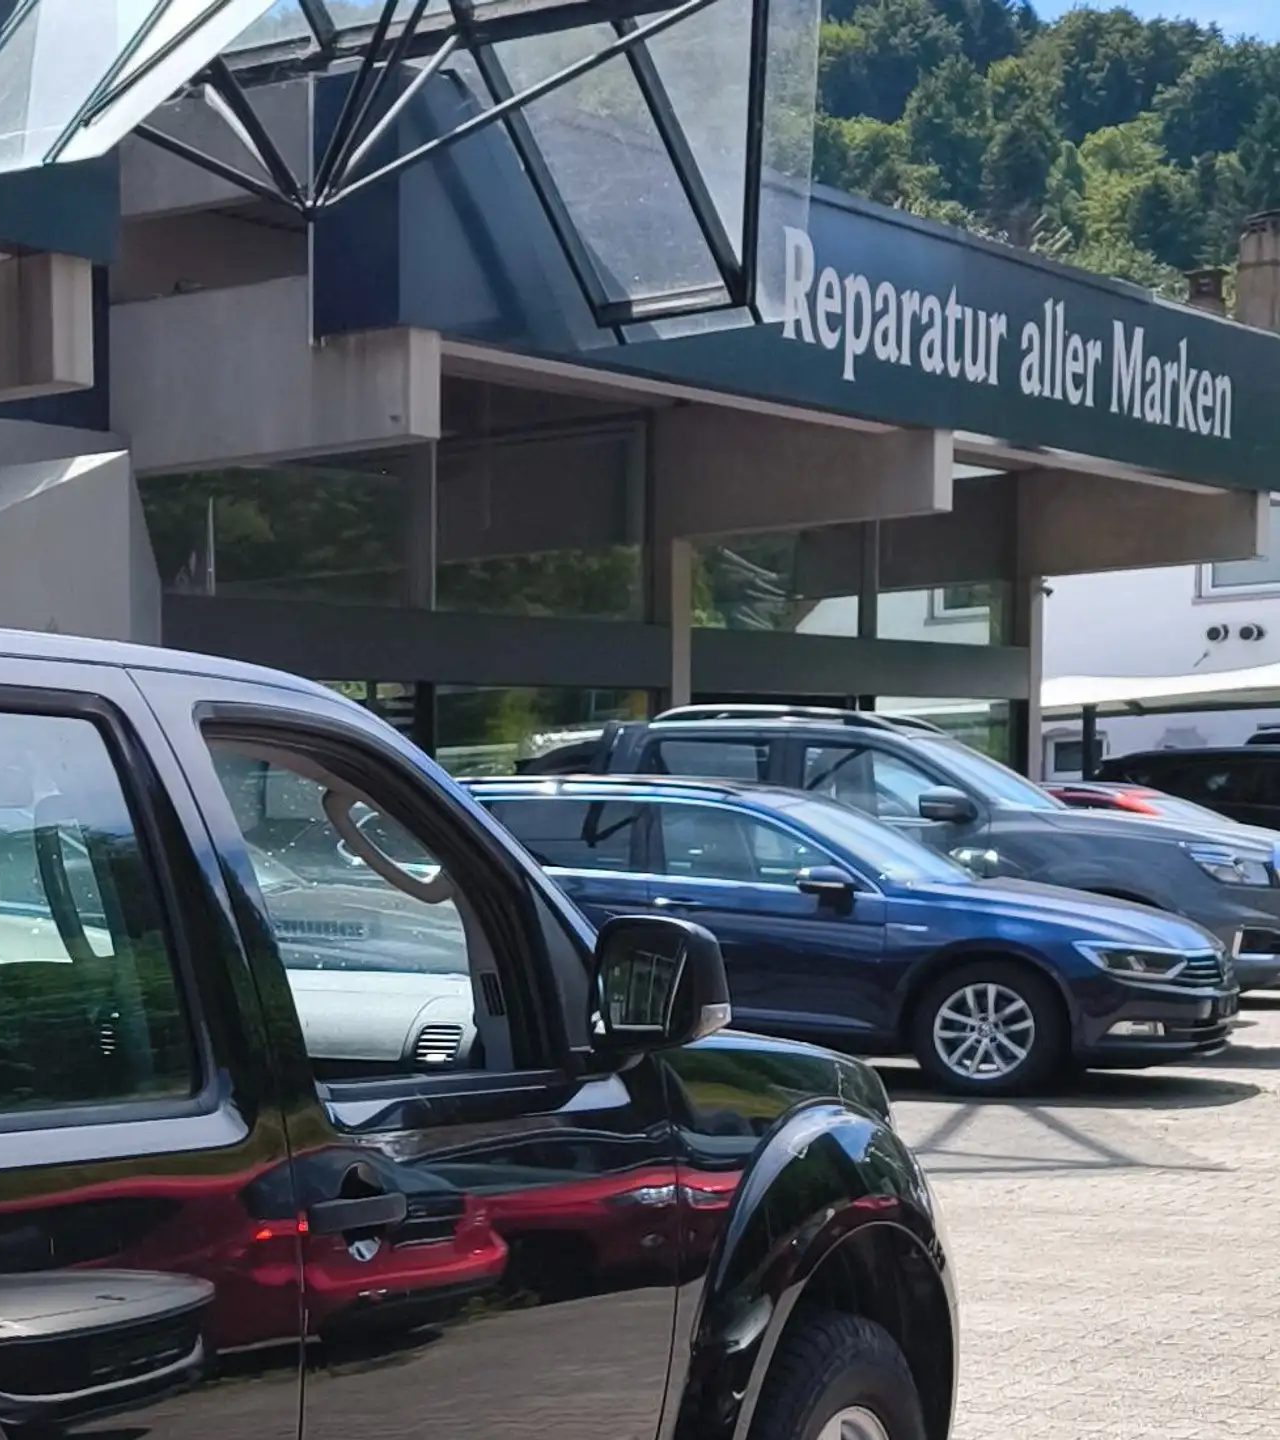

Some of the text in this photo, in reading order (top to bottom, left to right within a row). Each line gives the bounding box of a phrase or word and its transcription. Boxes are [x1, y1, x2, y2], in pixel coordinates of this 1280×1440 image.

[782, 225, 1233, 439] Reparatur aller Marken
